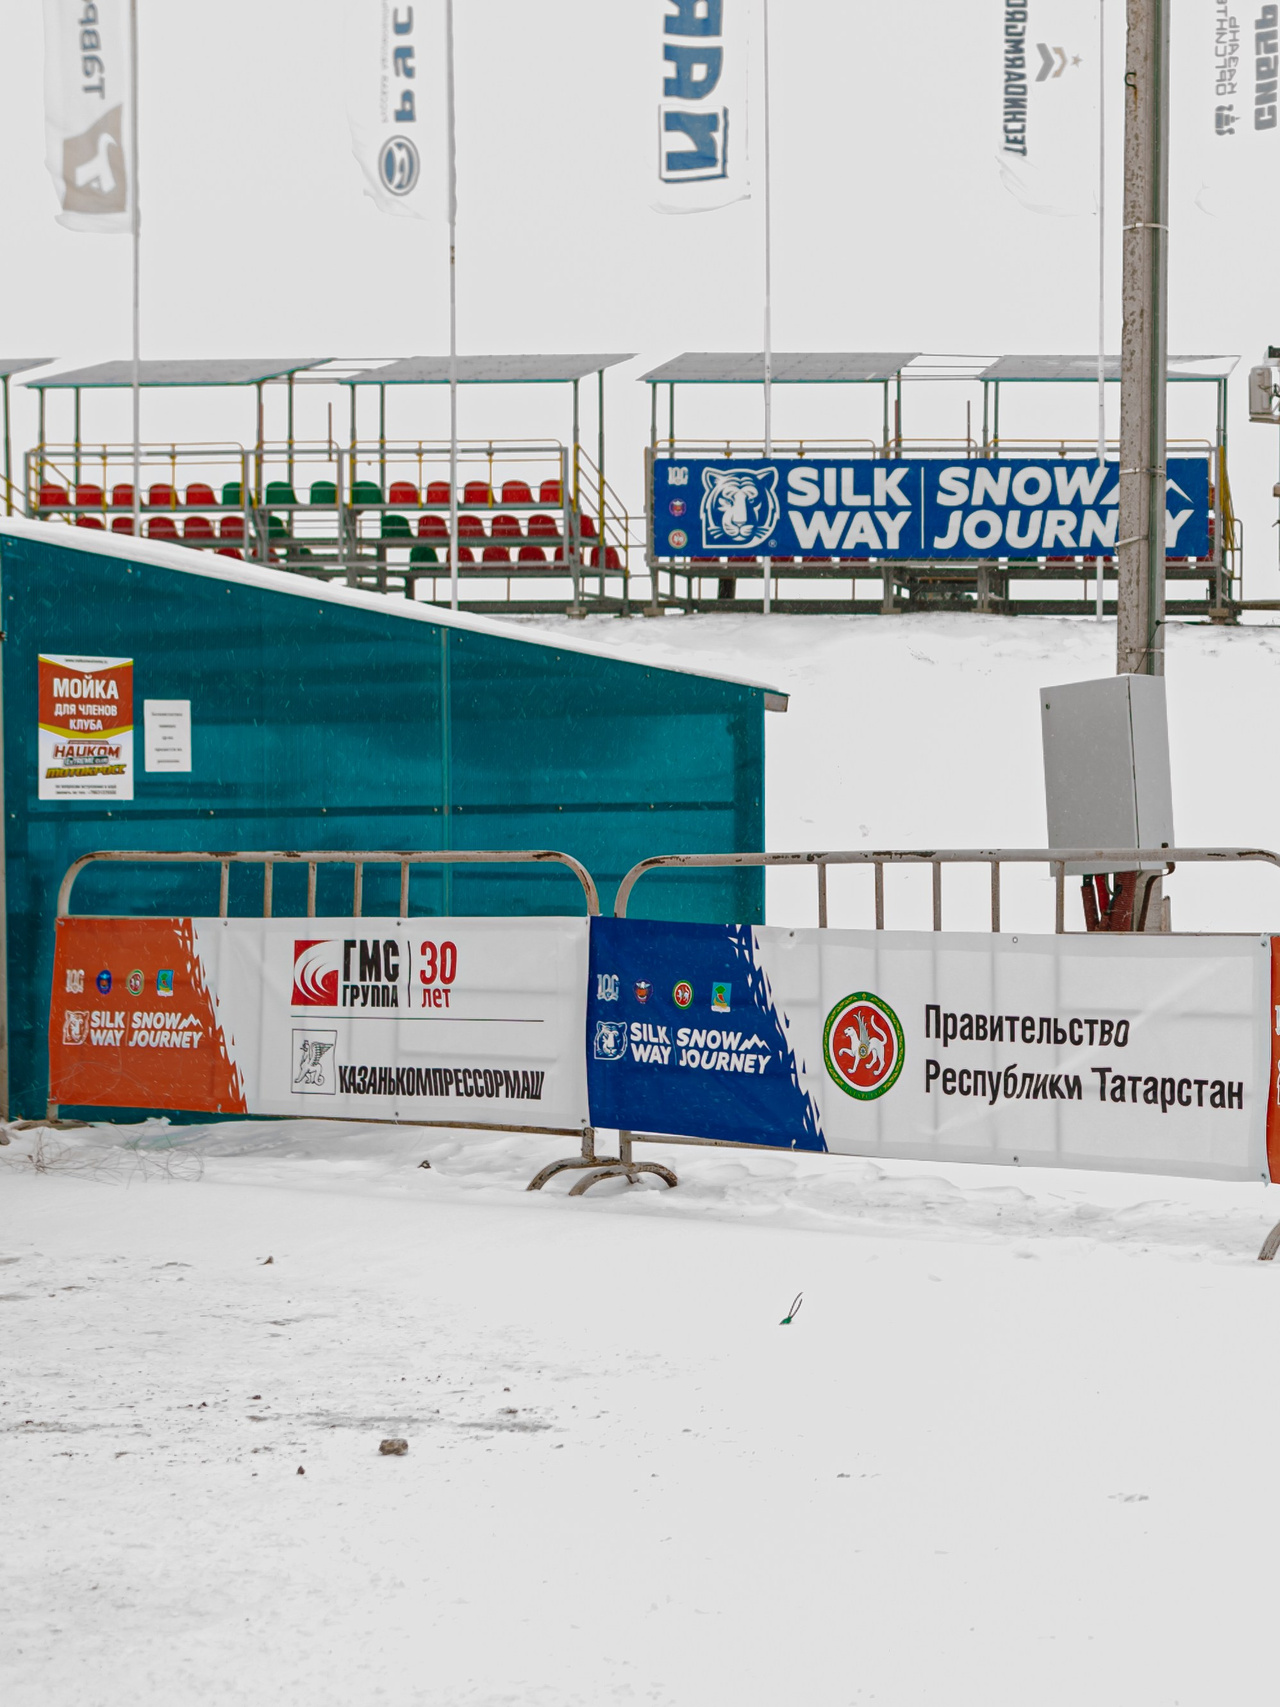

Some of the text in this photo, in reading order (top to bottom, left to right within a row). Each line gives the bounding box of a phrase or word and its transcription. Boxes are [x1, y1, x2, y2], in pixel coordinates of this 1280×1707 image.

[788, 466, 1102, 506] SILK SNOW
[788, 509, 1195, 550] WAY JOURNY
[53, 674, 119, 699] МОЙКА
[54, 703, 118, 717] ДЛЯ ЧЛЕНОВ
[69, 719, 103, 730] КЛУБА
[343, 939, 458, 985] ГМС 30
[342, 984, 451, 1008] ГРУППА лет
[90, 1011, 181, 1029] SILK SNOW
[925, 1004, 1130, 1048] Правительство
[90, 1029, 203, 1048] WAY JOURNEY
[630, 1022, 742, 1051] SILK SNOW
[630, 1044, 771, 1074] WAY JOURNEY
[338, 1065, 545, 1100] КАЗАНЬКОМПРЕССОРМАШ
[925, 1059, 1245, 1113] Республики Татарстан
